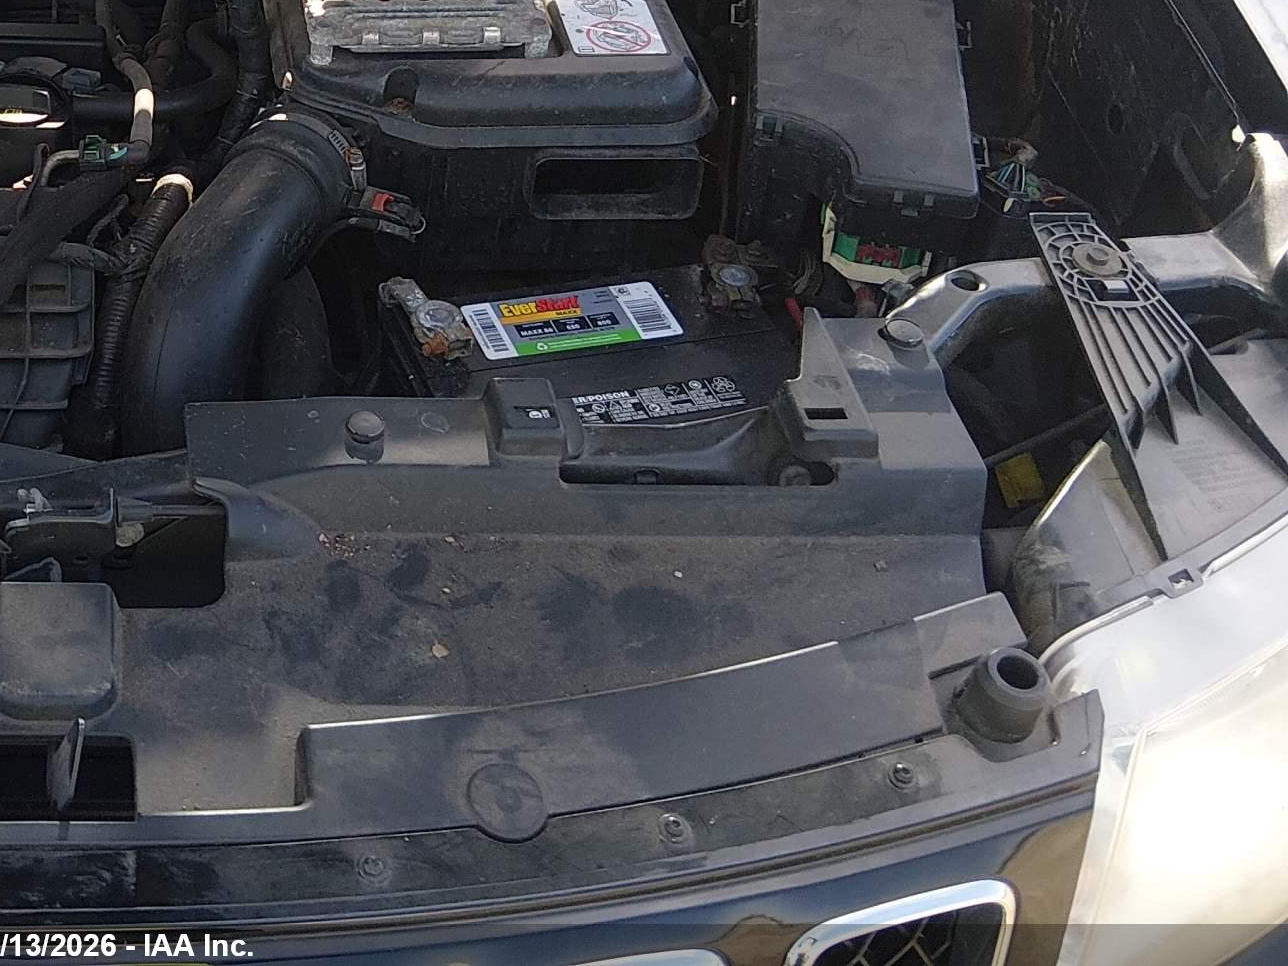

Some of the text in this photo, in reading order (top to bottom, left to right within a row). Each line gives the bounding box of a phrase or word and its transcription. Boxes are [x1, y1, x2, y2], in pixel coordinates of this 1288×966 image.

[498, 295, 580, 318] EverStart
[520, 328, 544, 337] MAXX
[572, 390, 630, 405] ER/POISON
